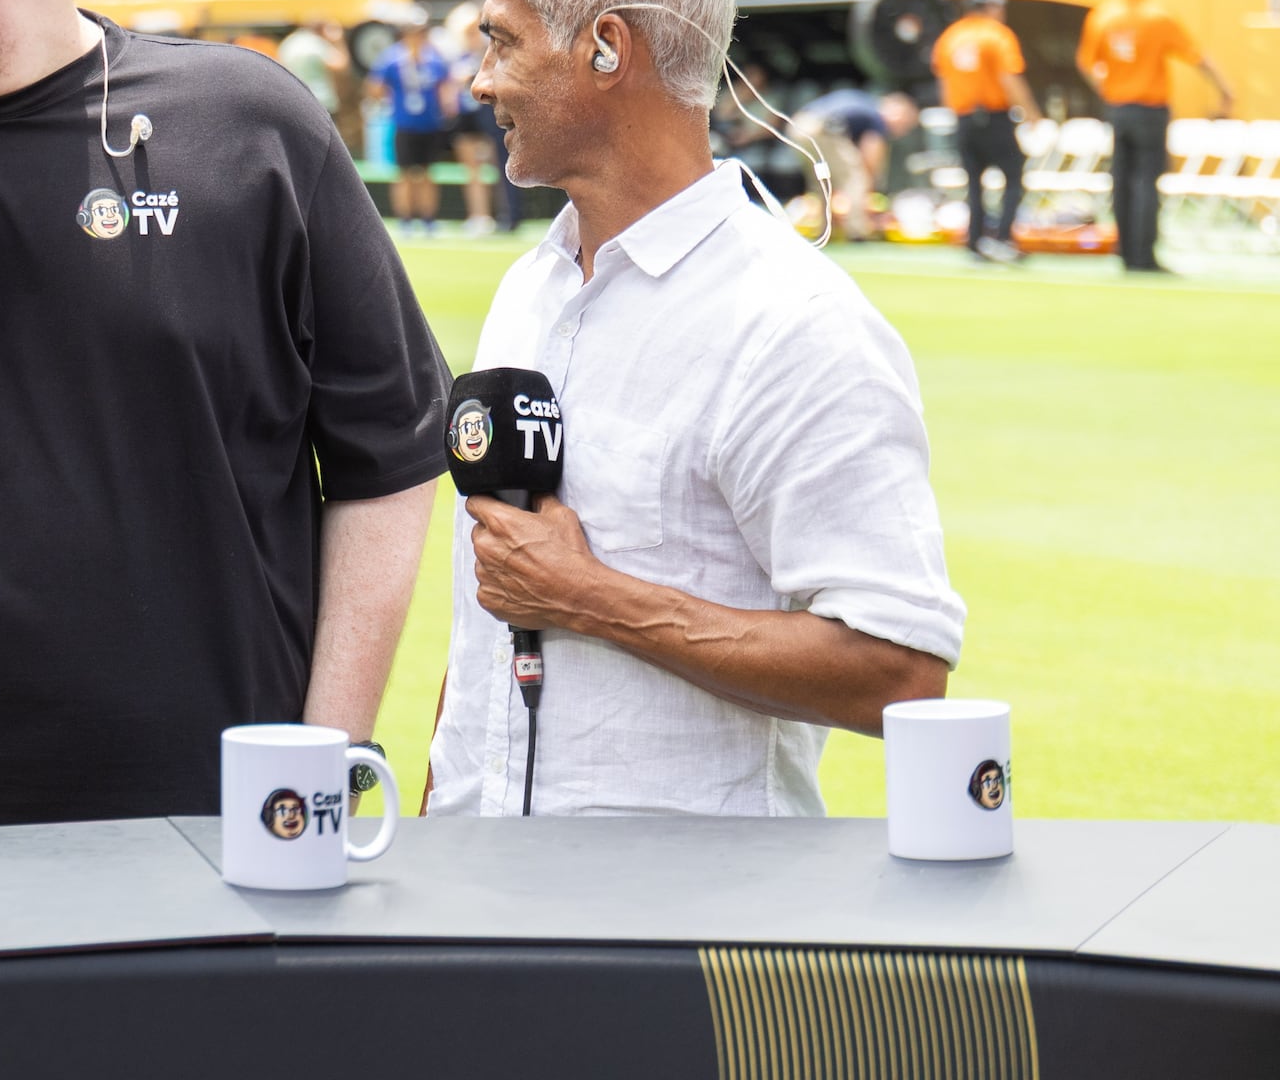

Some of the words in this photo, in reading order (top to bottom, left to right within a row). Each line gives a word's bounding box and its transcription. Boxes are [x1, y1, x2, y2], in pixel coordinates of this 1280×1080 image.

[131, 190, 179, 208] Cazé
[132, 207, 180, 236] TV
[513, 394, 561, 419] Cazé
[516, 419, 563, 462] TV
[313, 807, 343, 836] TV
